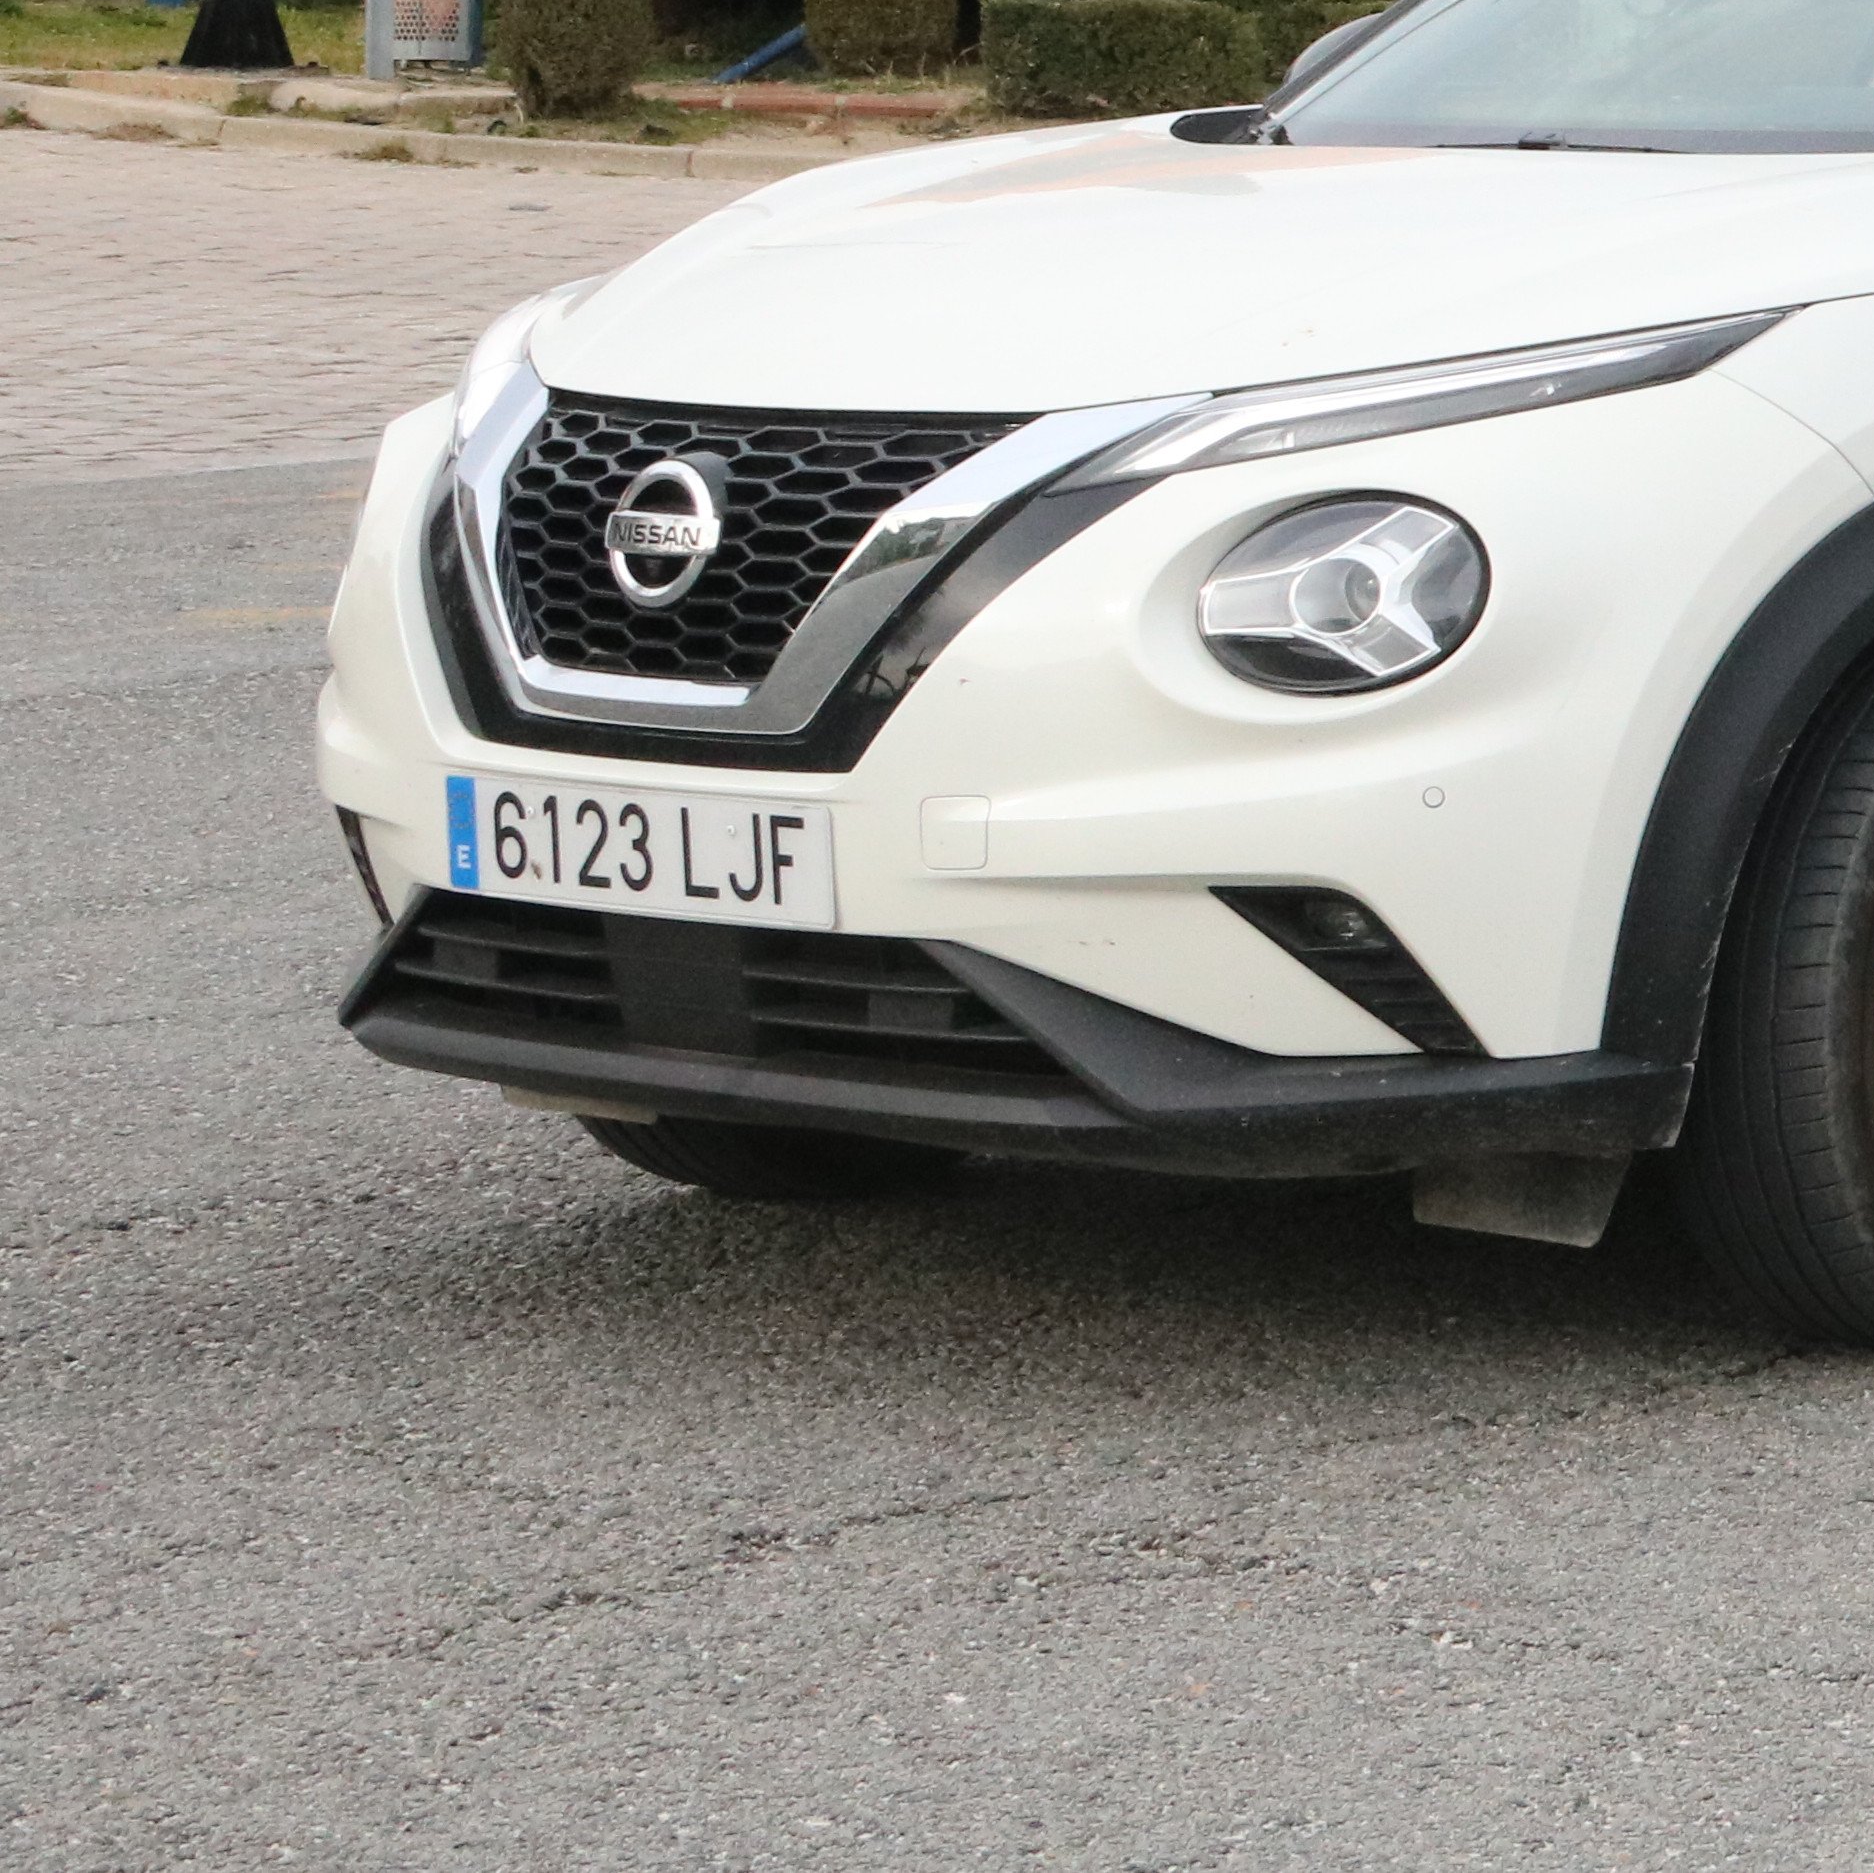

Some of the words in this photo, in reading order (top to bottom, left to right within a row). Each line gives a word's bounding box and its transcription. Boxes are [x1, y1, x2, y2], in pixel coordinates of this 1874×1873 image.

[613, 522, 701, 547] NISSAN
[493, 790, 654, 892] 6123
[681, 805, 805, 905] LJF
